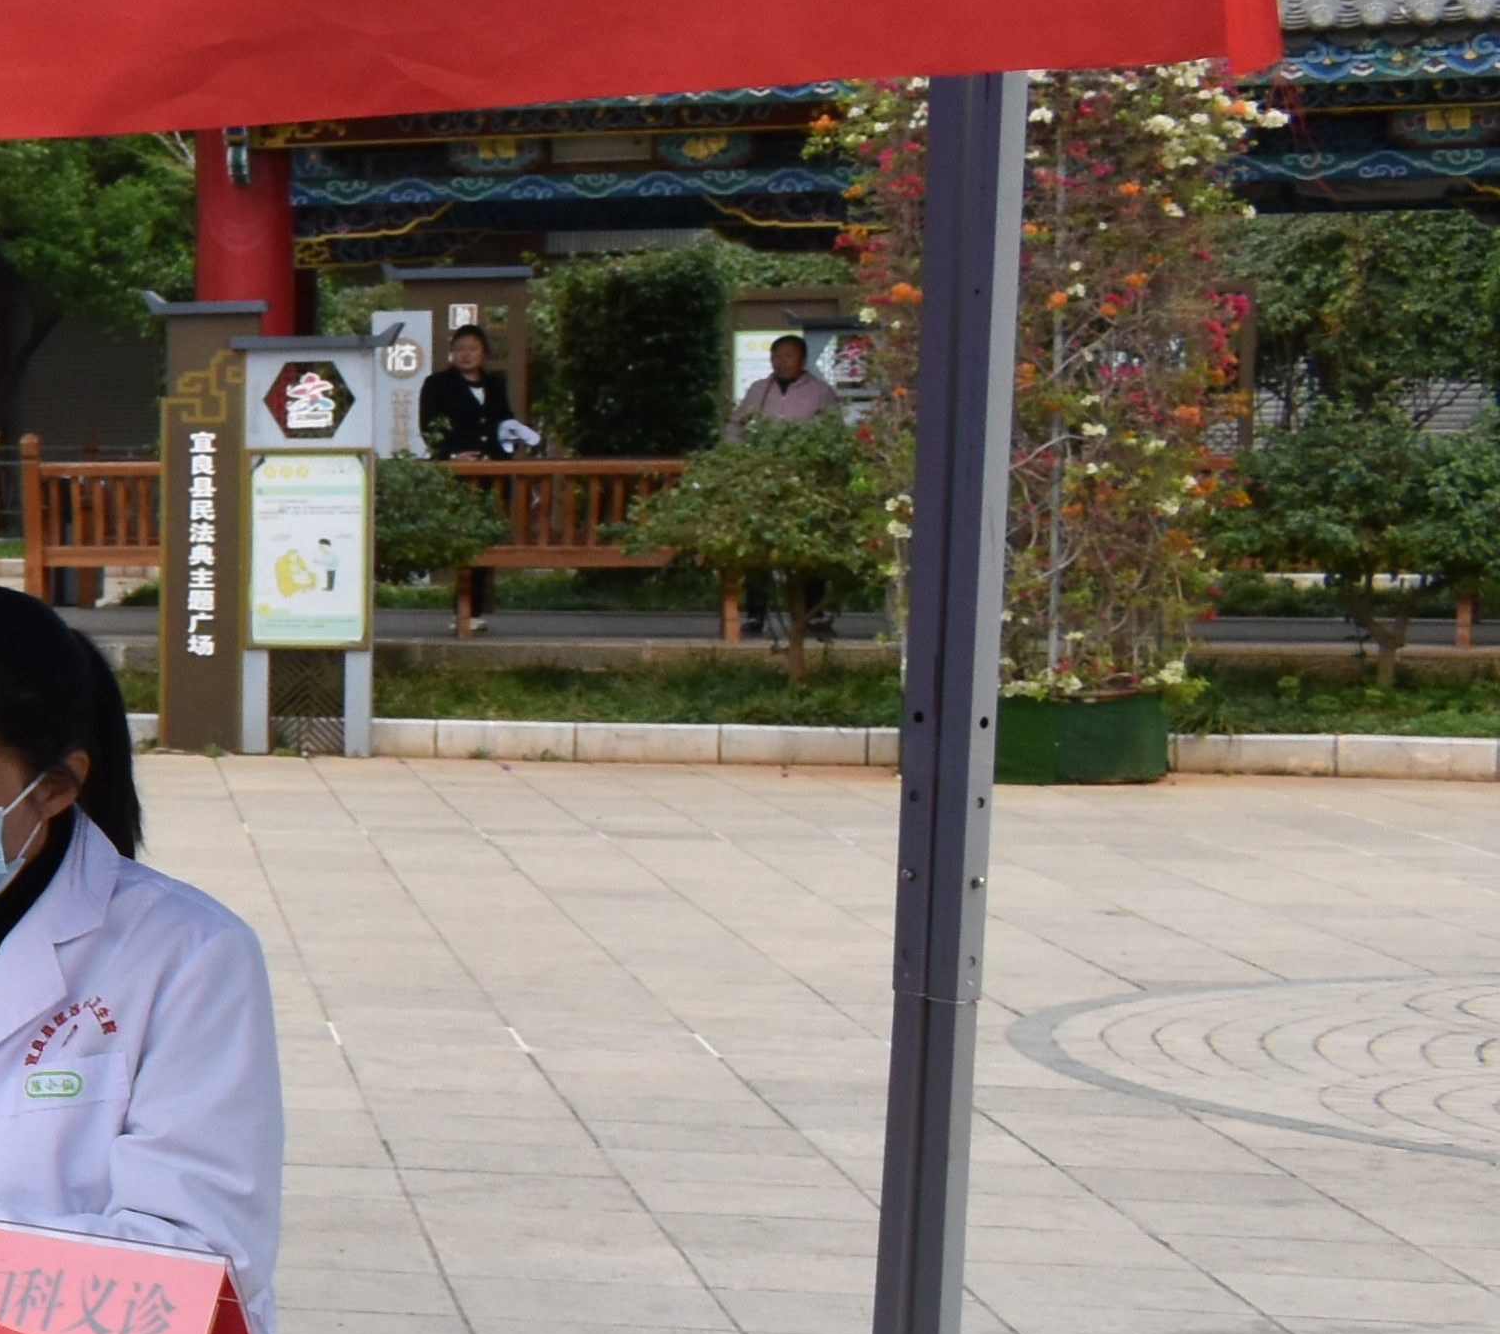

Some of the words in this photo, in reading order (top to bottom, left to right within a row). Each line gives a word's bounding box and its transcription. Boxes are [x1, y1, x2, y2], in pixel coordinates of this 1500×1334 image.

[187, 431, 217, 657] 宜良县民法典主题广场
